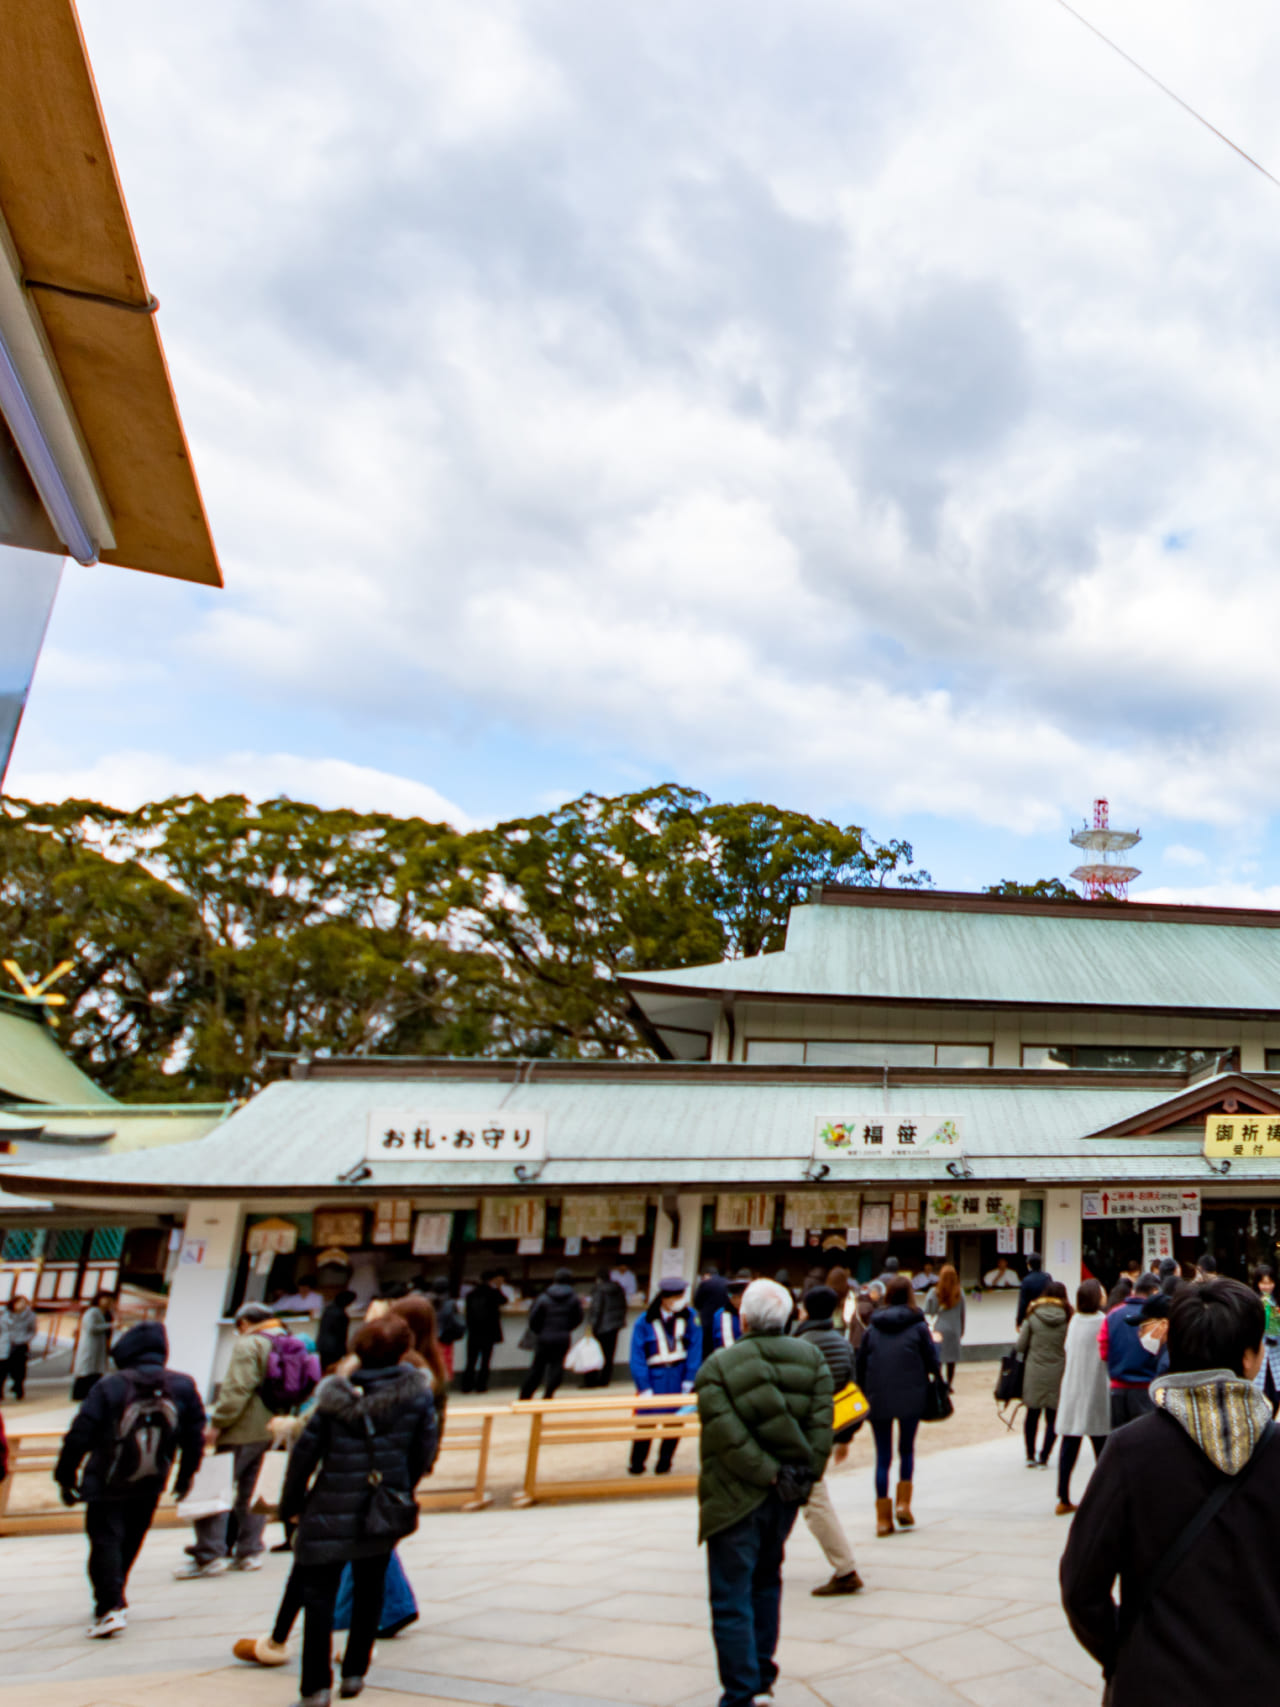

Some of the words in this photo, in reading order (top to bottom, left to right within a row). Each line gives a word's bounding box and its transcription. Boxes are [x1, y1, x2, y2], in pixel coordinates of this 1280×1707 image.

[382, 1127, 531, 1150] お札・お守り
[862, 1124, 918, 1145] 福笹
[1232, 1144, 1264, 1156] 受付
